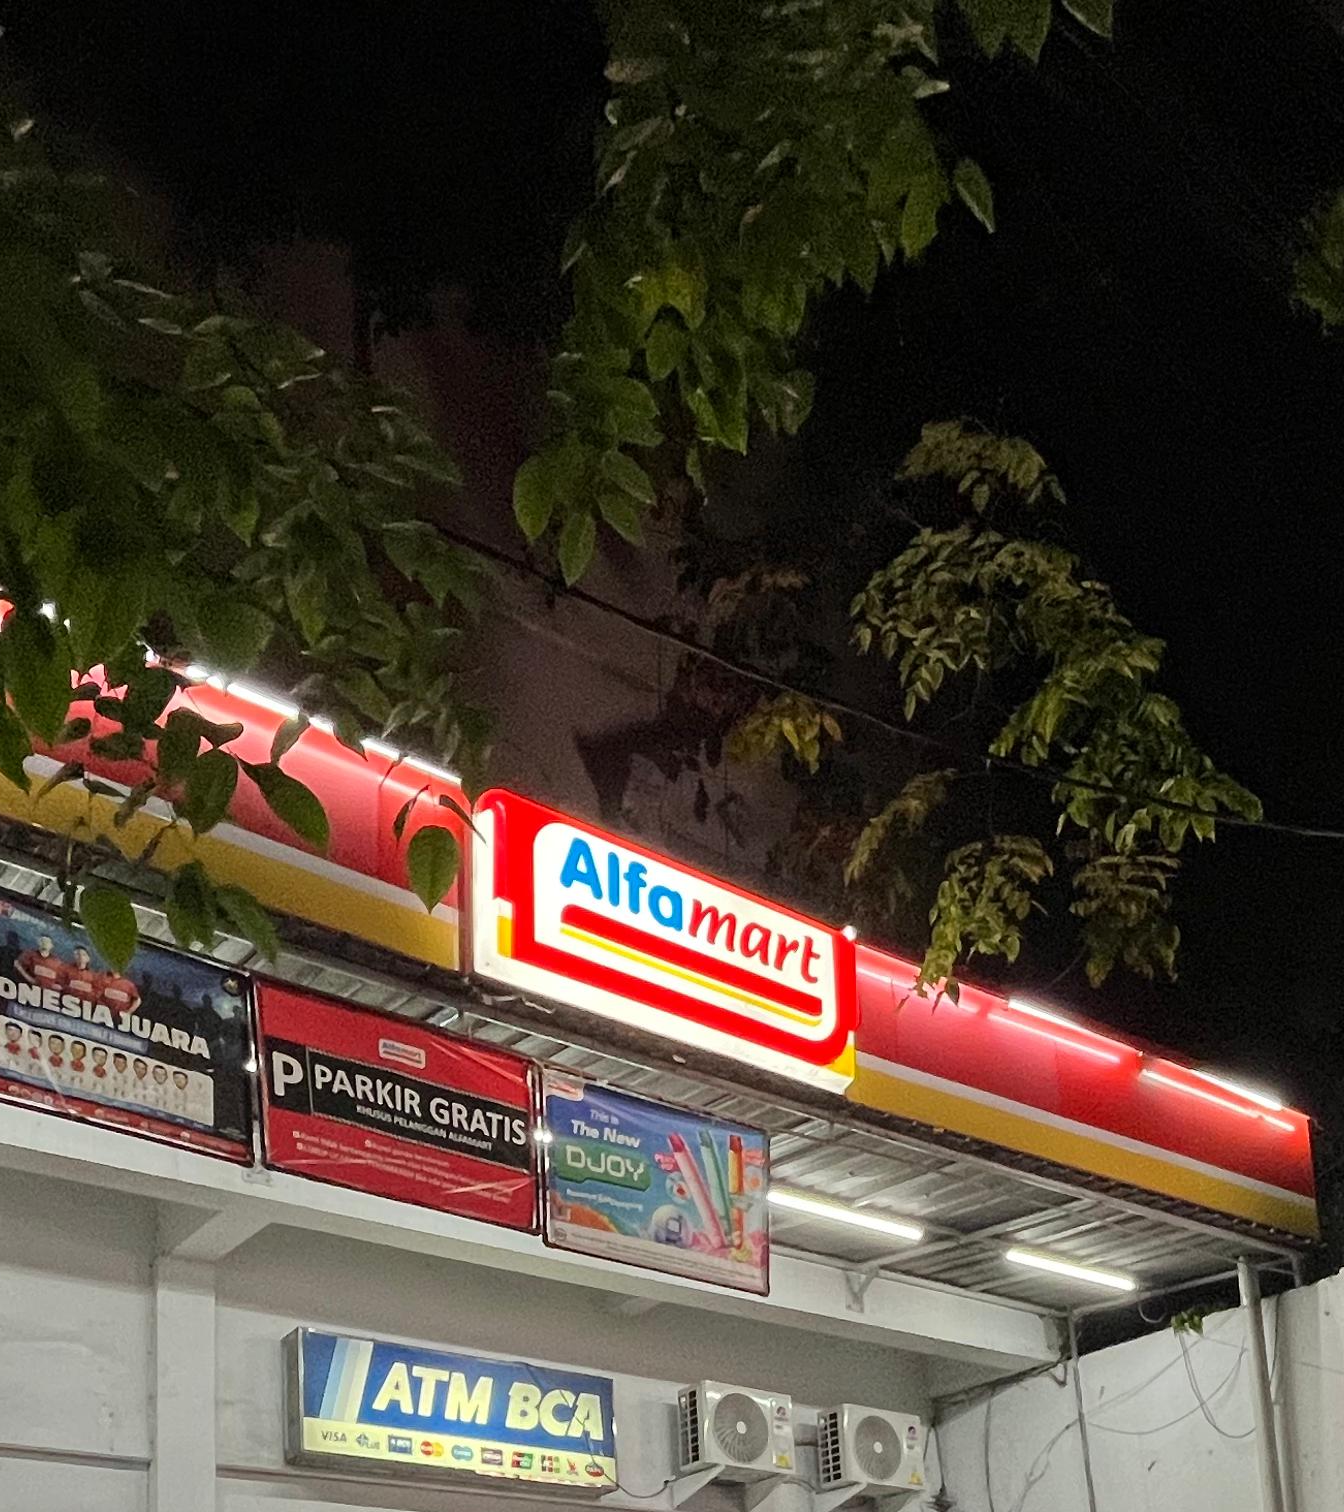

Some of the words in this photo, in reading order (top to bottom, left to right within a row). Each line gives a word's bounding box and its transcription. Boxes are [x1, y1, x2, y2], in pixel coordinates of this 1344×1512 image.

[560, 837, 821, 984] Alfamart
[118, 1010, 211, 1059] JUARA
[273, 1051, 304, 1096] P
[315, 1064, 421, 1116] PARKIR
[429, 1098, 526, 1146] GRATIS
[571, 1119, 599, 1139] The
[604, 1127, 641, 1149] New
[566, 1144, 645, 1182] DJOY
[372, 1362, 493, 1425] ATM
[505, 1382, 604, 1440] BCA
[321, 1430, 347, 1443] VISA
